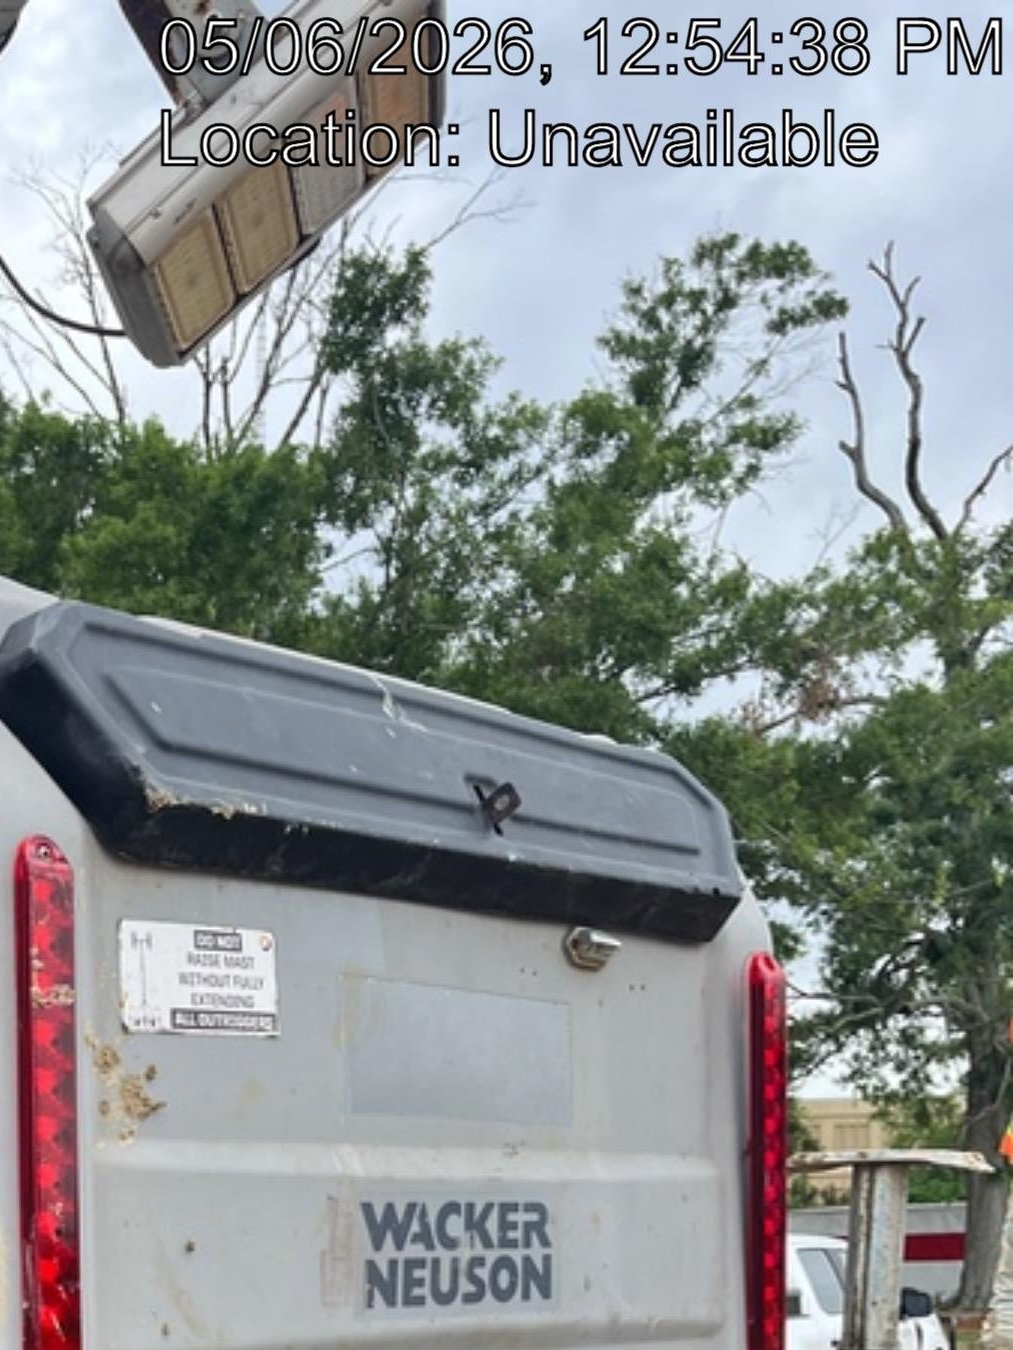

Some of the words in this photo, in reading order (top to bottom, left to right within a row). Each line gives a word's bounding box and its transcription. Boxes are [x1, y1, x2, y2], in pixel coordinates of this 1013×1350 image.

[196, 932, 216, 949] DO
[217, 934, 239, 951] NOT
[187, 953, 222, 968] RAISE
[224, 955, 255, 970] MAST
[178, 972, 230, 988] WITHOUT
[232, 976, 265, 991] FULLY
[190, 992, 255, 1009] EXTENDING
[175, 1011, 197, 1028] ALL
[359, 1200, 553, 1252] WACKER
[364, 1253, 553, 1309] NEUSON
